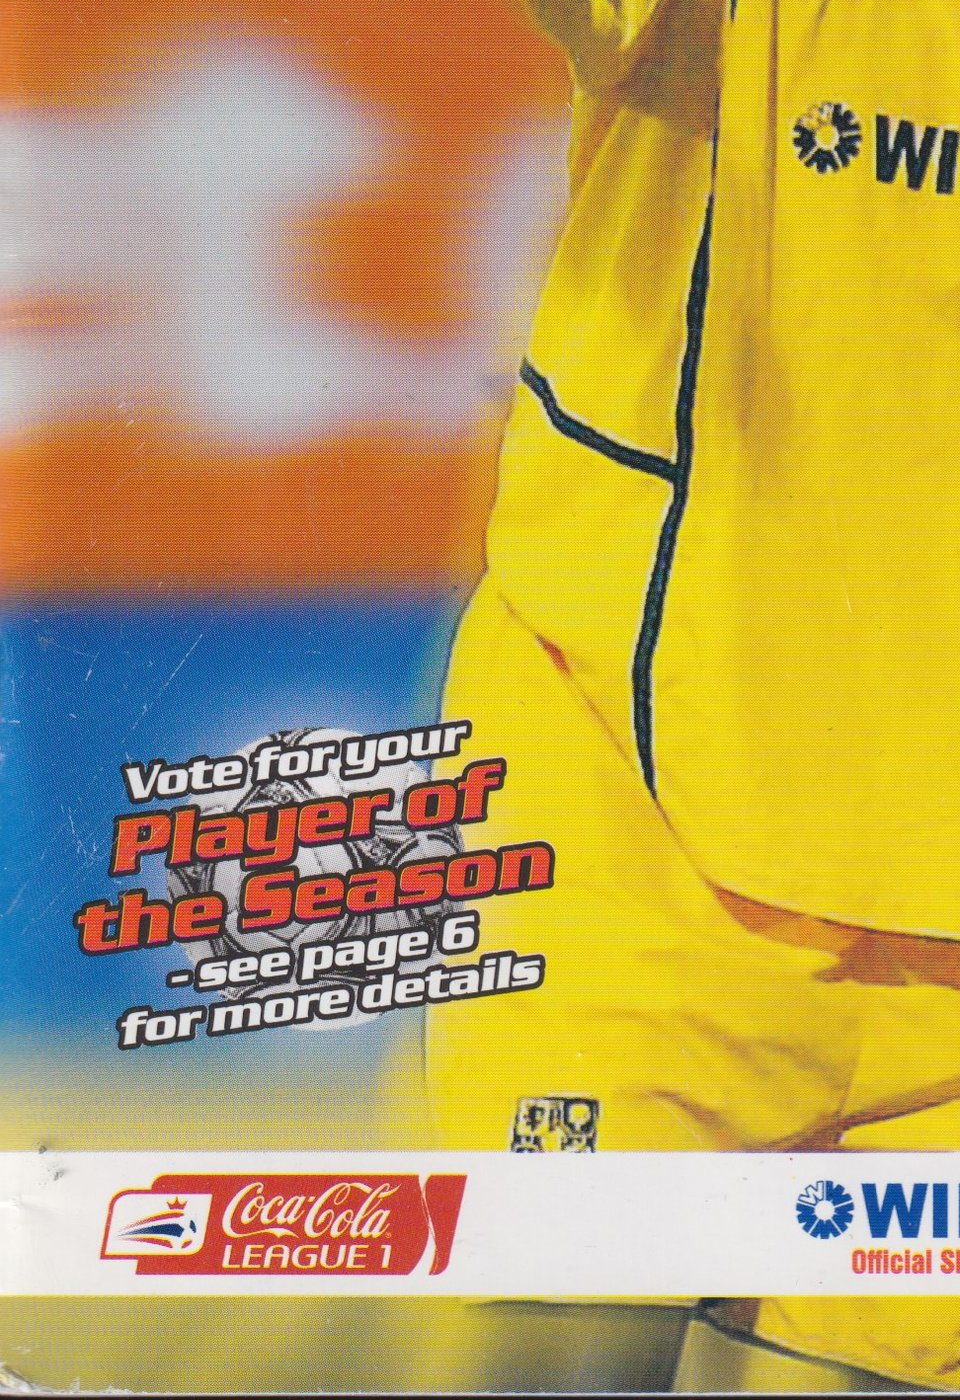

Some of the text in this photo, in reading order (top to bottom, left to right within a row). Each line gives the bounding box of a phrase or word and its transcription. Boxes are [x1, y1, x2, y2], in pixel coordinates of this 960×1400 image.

[125, 723, 469, 800] Vote for your
[110, 761, 504, 874] Player of
[78, 845, 555, 953] the Season
[199, 955, 292, 990] see
[300, 925, 429, 982] page
[441, 914, 478, 952] 6
[119, 955, 543, 1047] for more details
[222, 1181, 402, 1239] Coca-Cola
[222, 1244, 393, 1270] LEAGUE 1
[851, 1249, 932, 1275] Official
